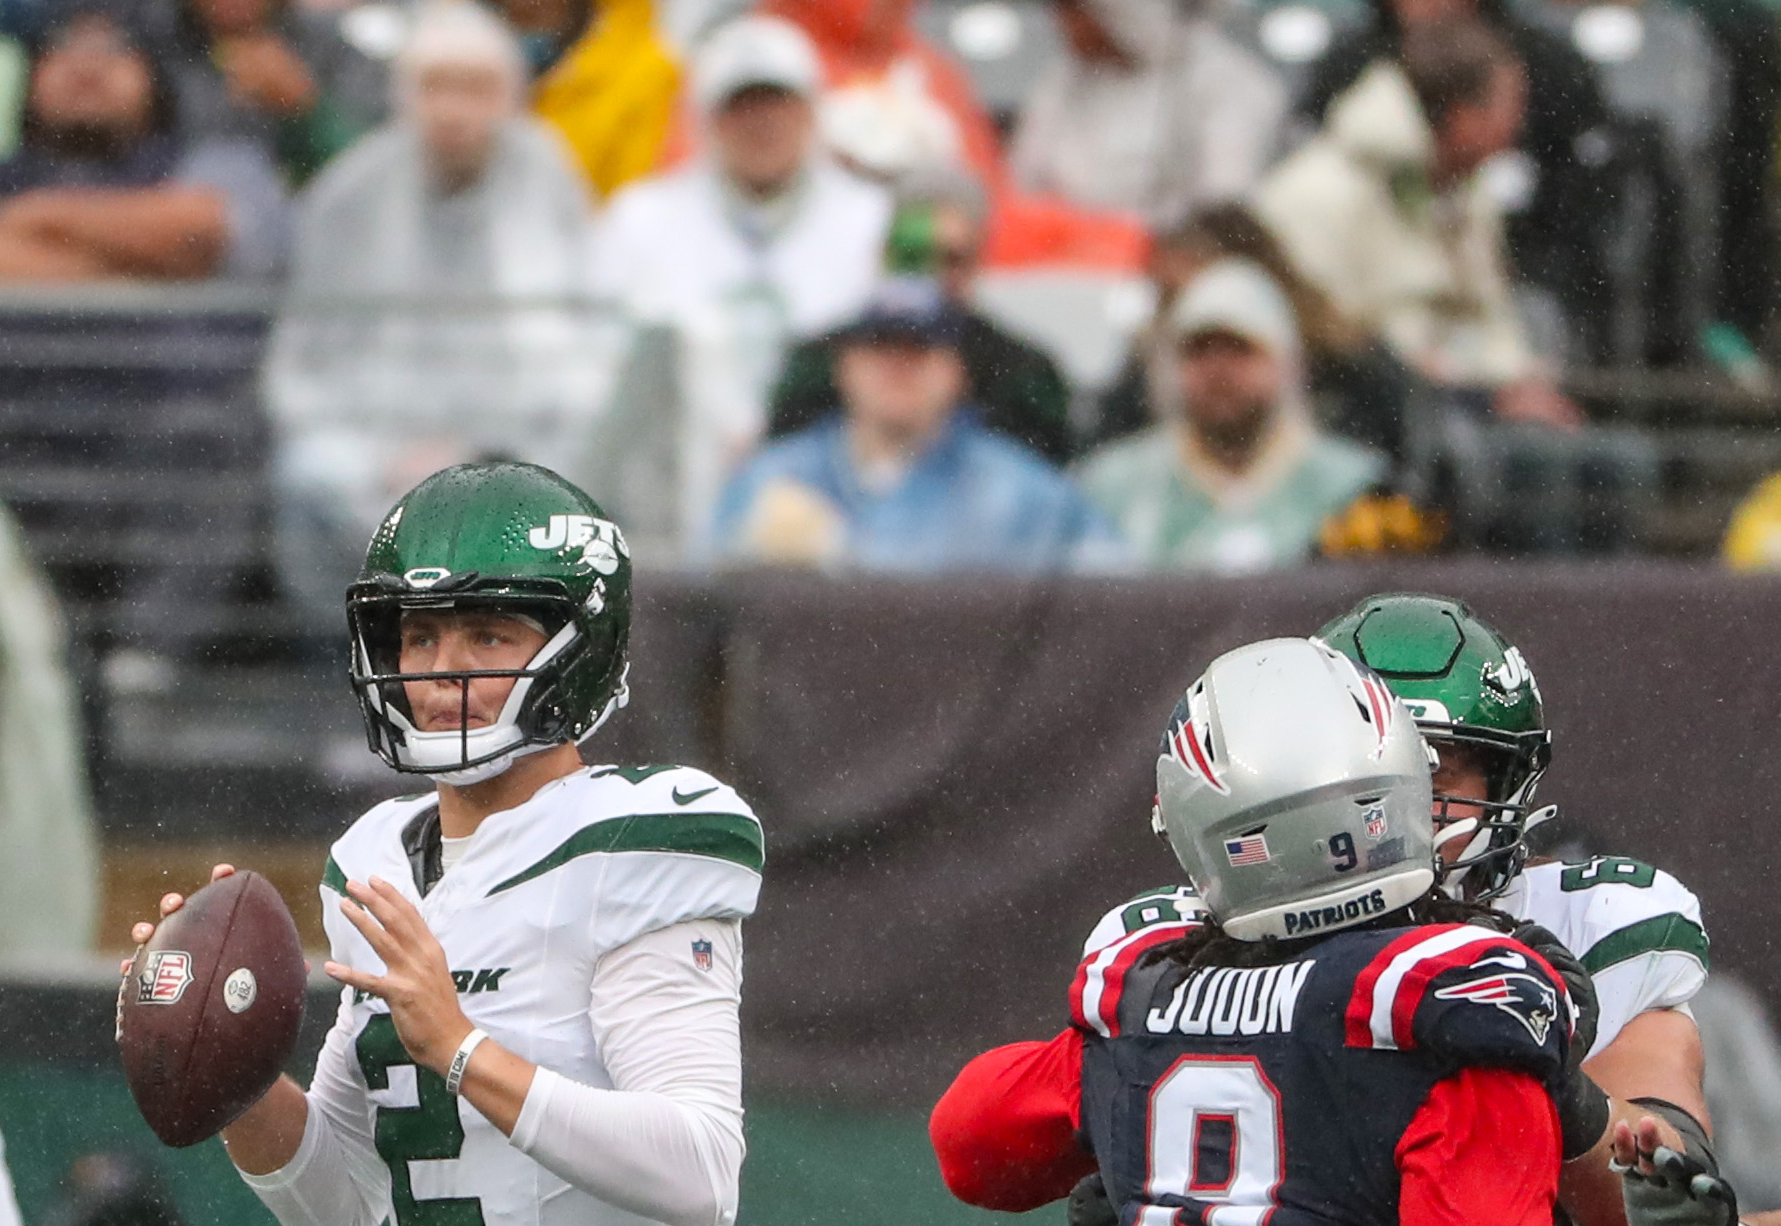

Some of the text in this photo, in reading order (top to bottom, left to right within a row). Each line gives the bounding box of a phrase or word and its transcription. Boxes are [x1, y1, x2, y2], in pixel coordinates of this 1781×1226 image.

[1367, 818, 1386, 836] NFL
[1329, 831, 1359, 873] 9
[1284, 888, 1387, 935] PATRIOTS
[154, 954, 186, 998] NFL
[451, 967, 511, 993] RK
[1145, 959, 1317, 1035] JUDON
